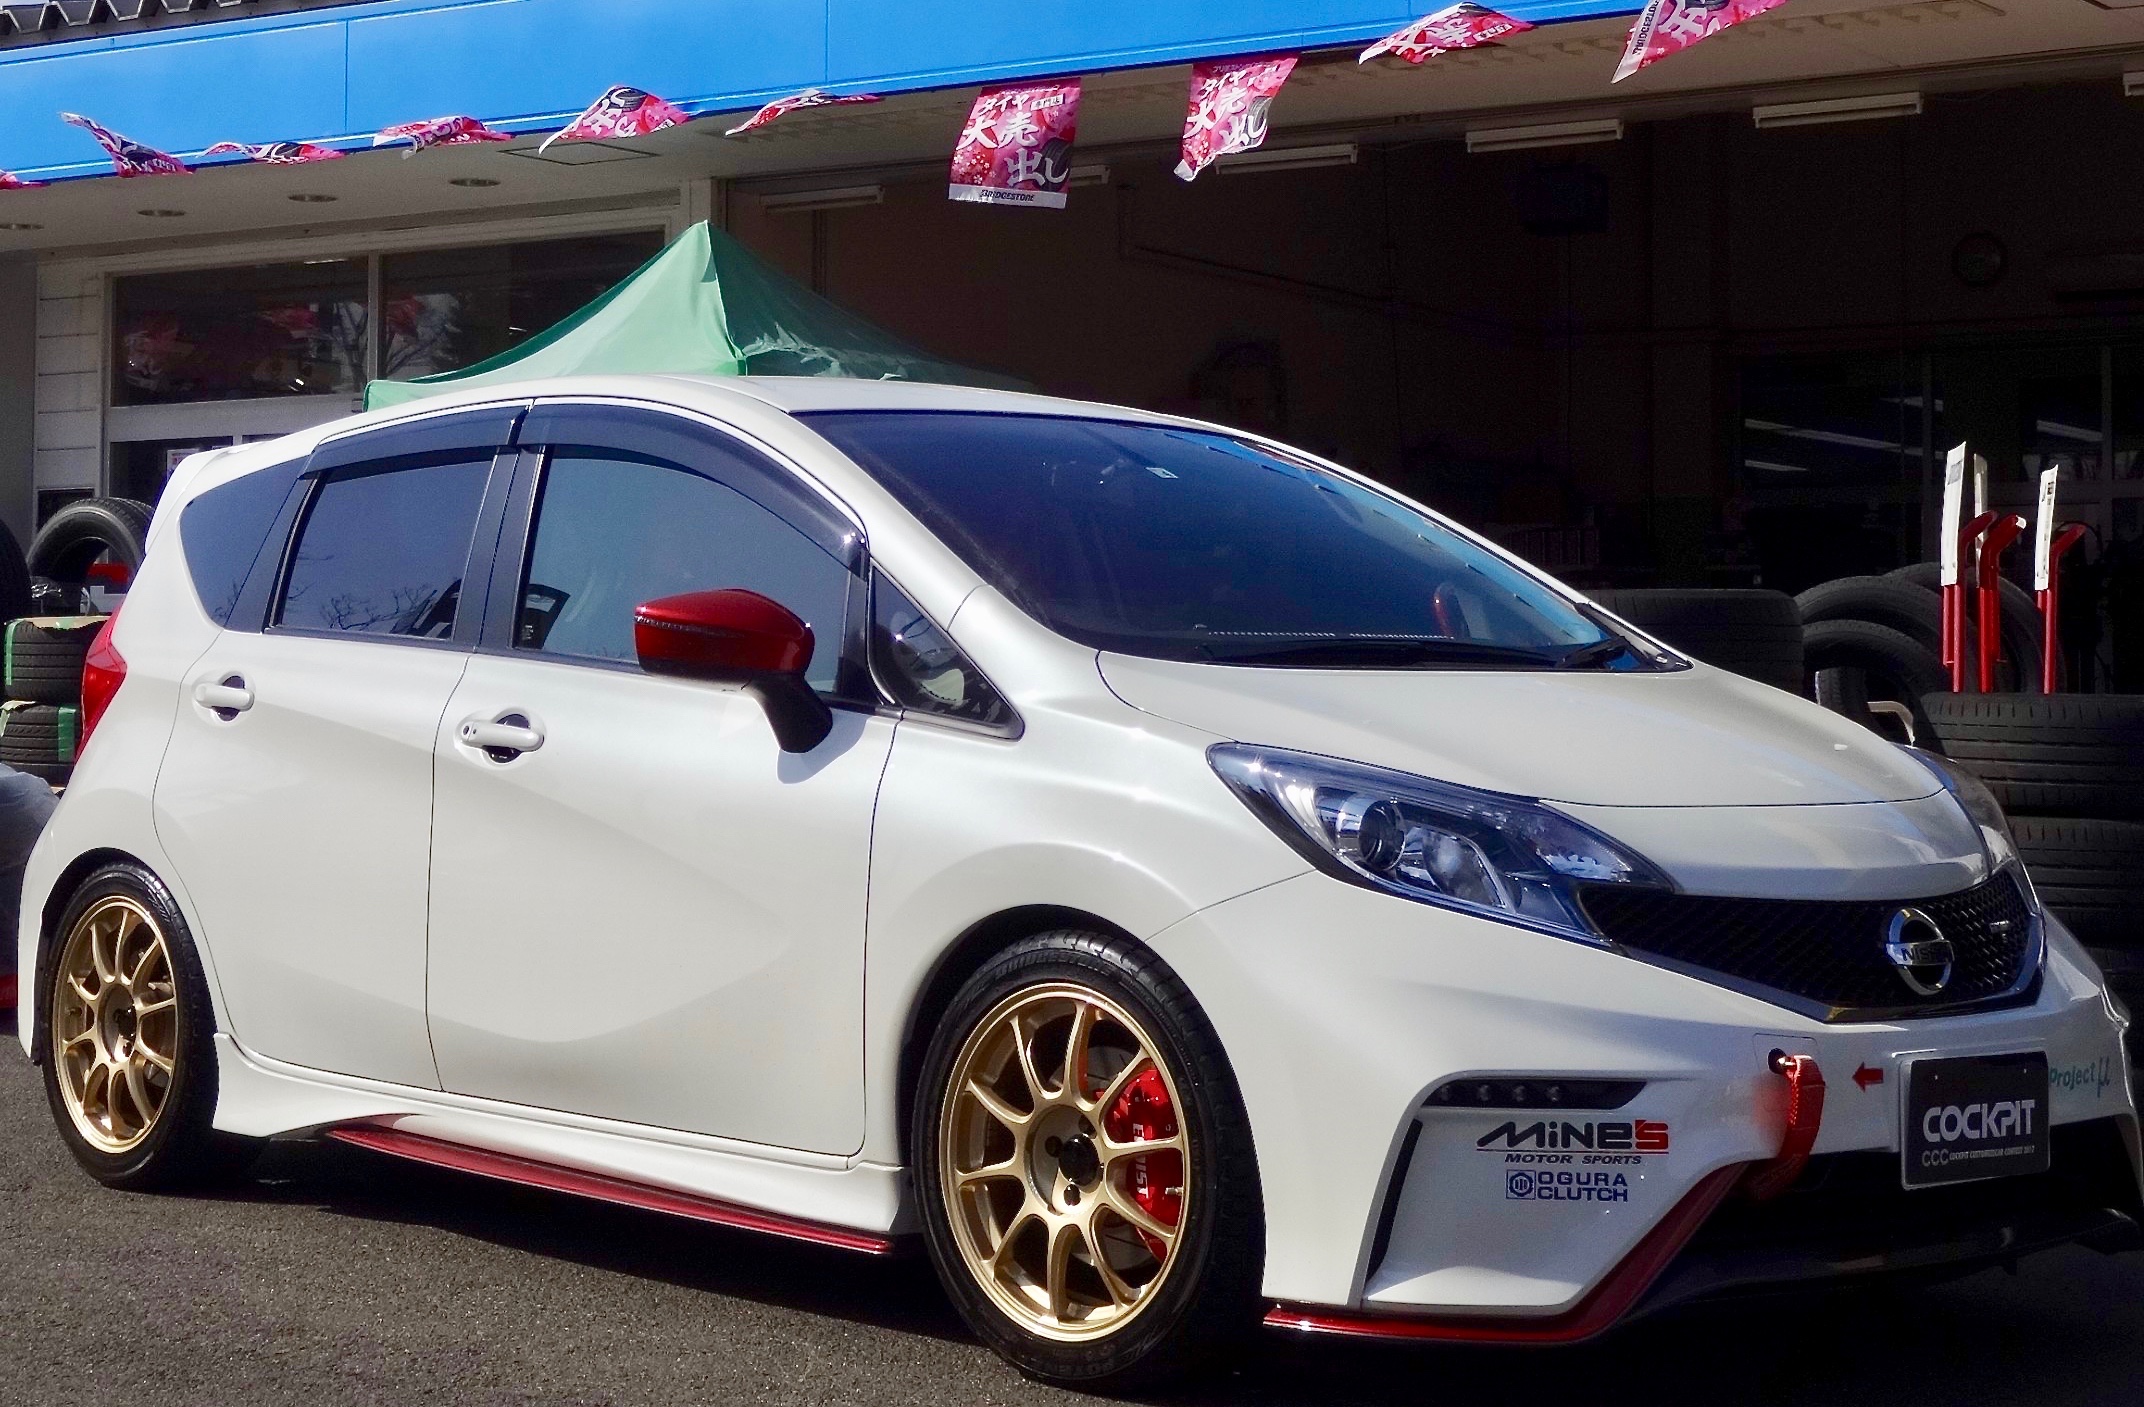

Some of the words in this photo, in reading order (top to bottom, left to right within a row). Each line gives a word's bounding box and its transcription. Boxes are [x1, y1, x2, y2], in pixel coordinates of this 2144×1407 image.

[1923, 1100, 2035, 1143] COCKPIT
[1505, 1153, 1573, 1164] MOTOR
[1581, 1155, 1643, 1165] SPORTS
[1922, 1149, 1949, 1167] CCC
[1537, 1172, 1628, 1187] OGURA
[1537, 1187, 1628, 1202] CLUTCH
